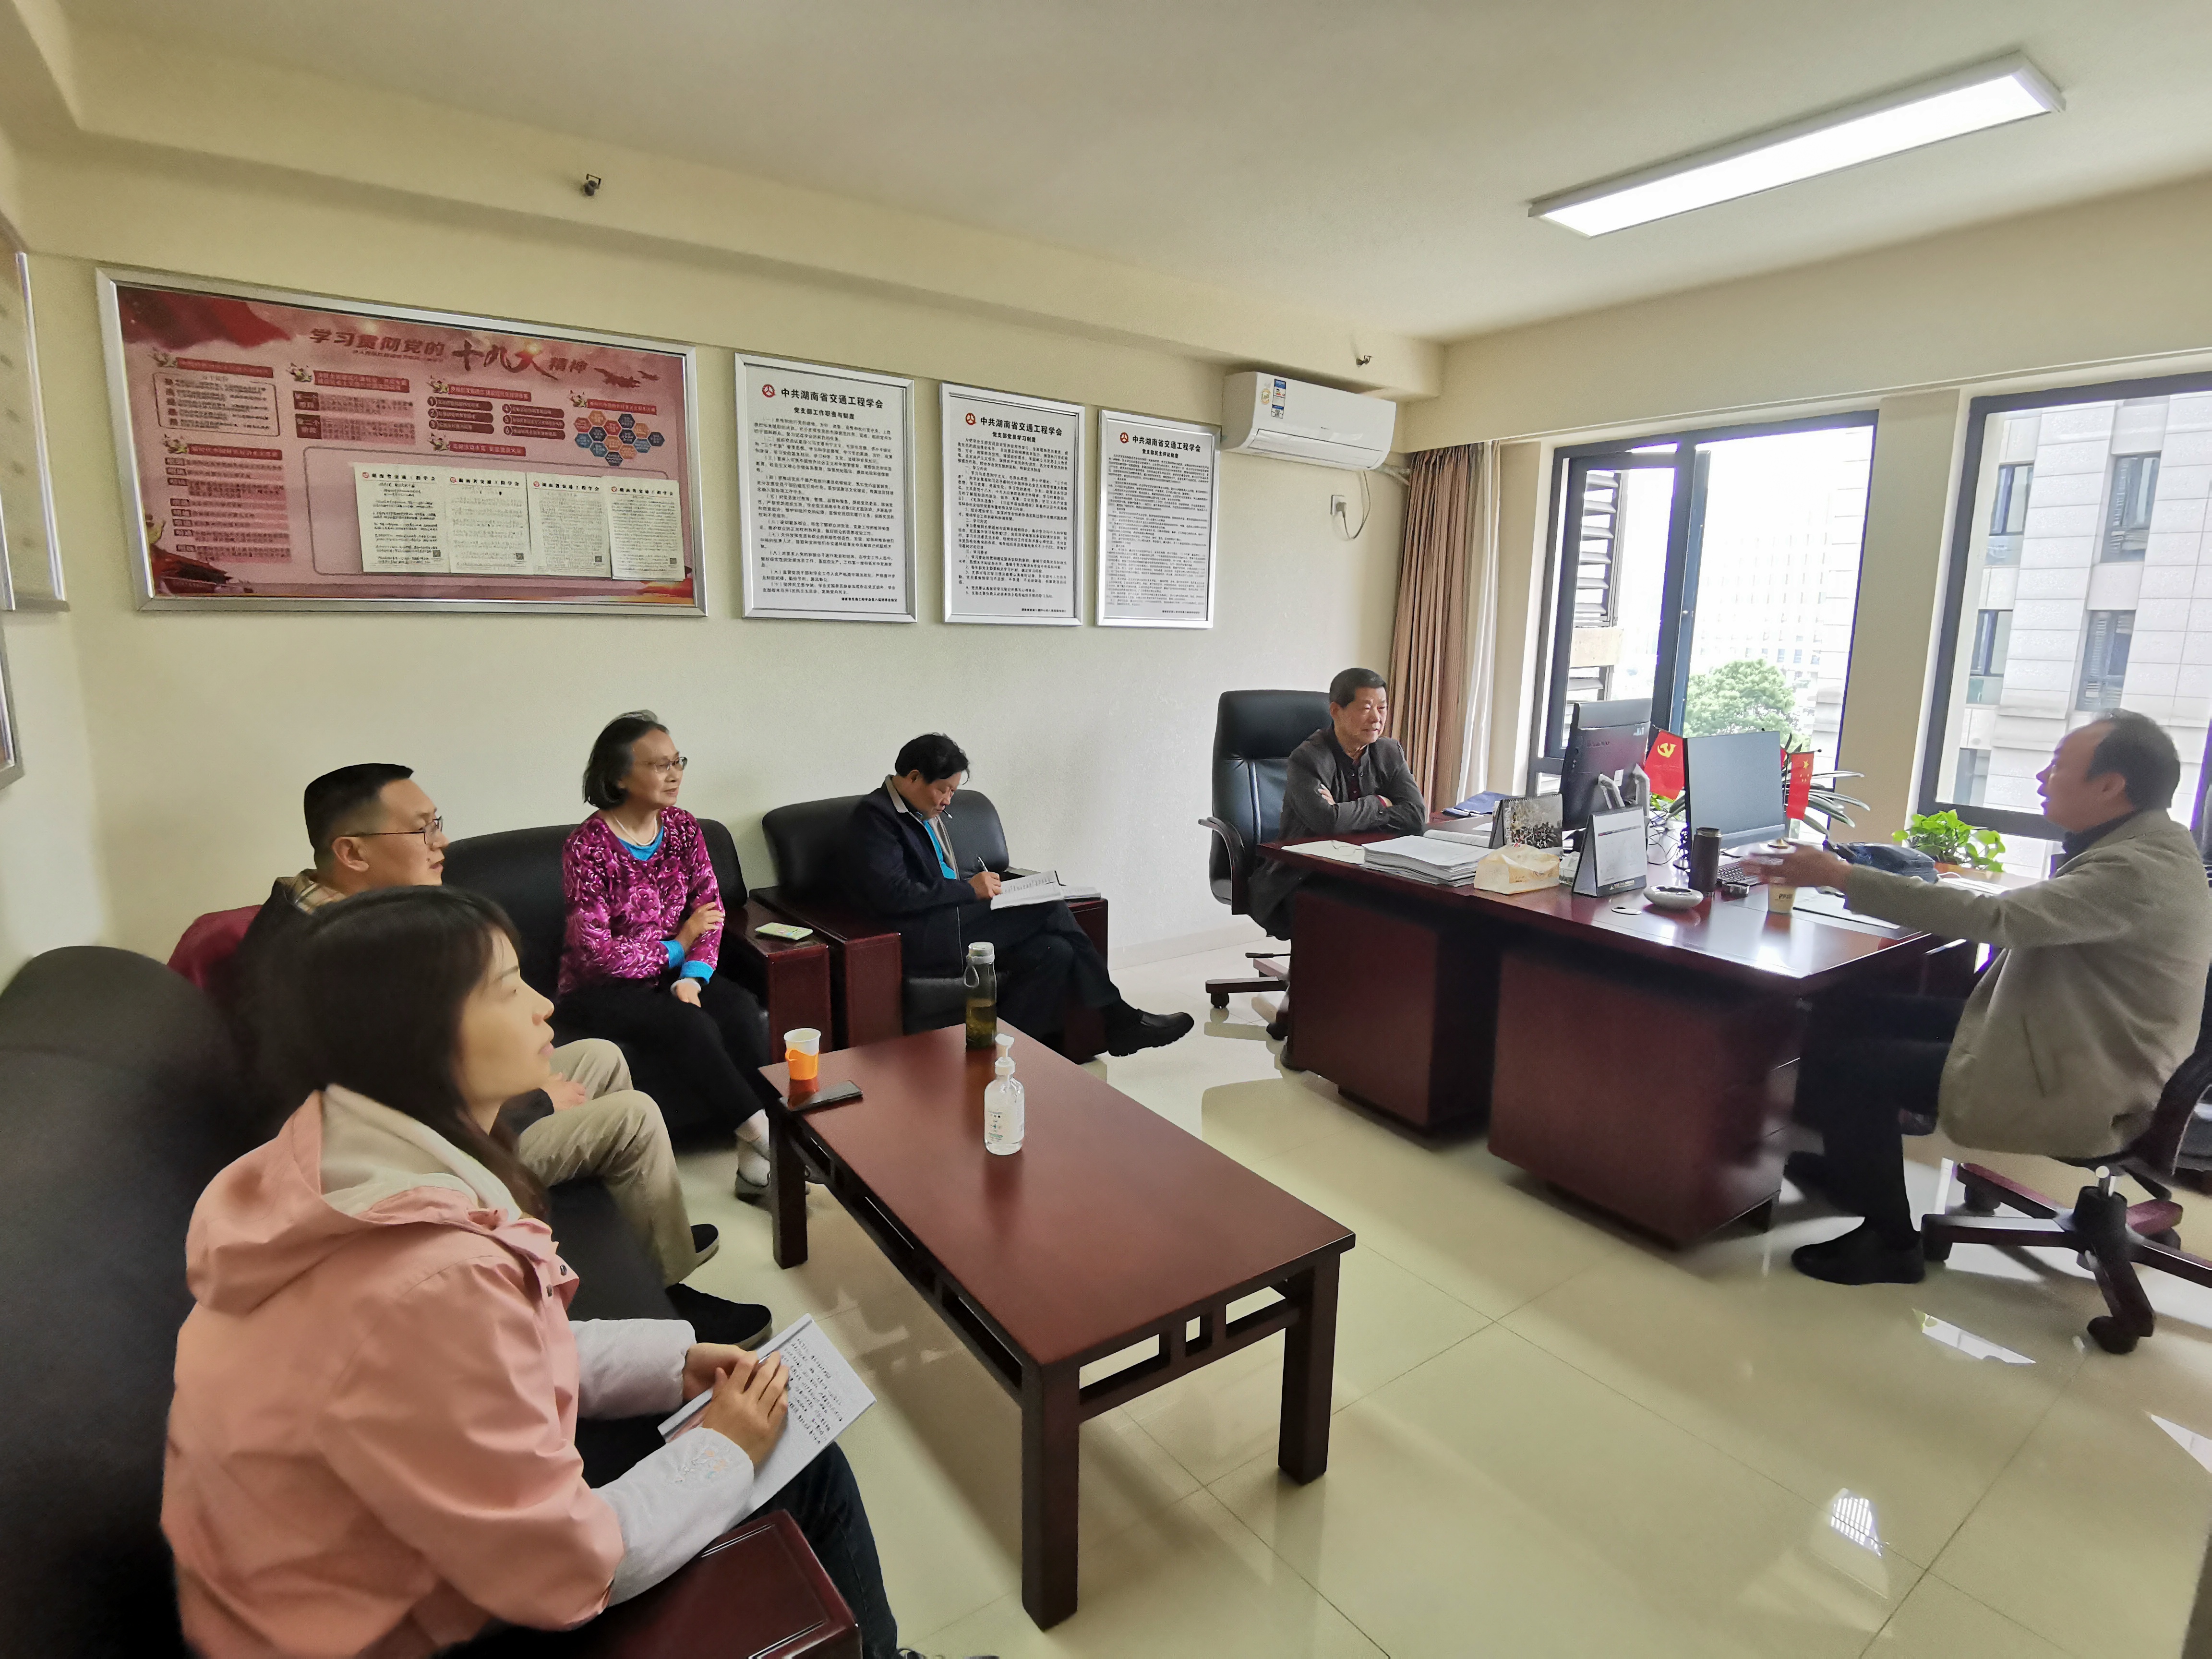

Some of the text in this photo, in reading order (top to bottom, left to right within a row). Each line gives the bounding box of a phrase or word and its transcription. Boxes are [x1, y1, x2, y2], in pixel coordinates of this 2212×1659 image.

[781, 388, 883, 409] 中共湖南省交通工程学会
[793, 407, 854, 420] 党支部工作职责与制度
[980, 417, 1062, 436] 中共湖南省交通工程学会
[992, 432, 1036, 443] 党支部党员学习制度
[1132, 435, 1201, 452] 中共湖南省交通工程学会
